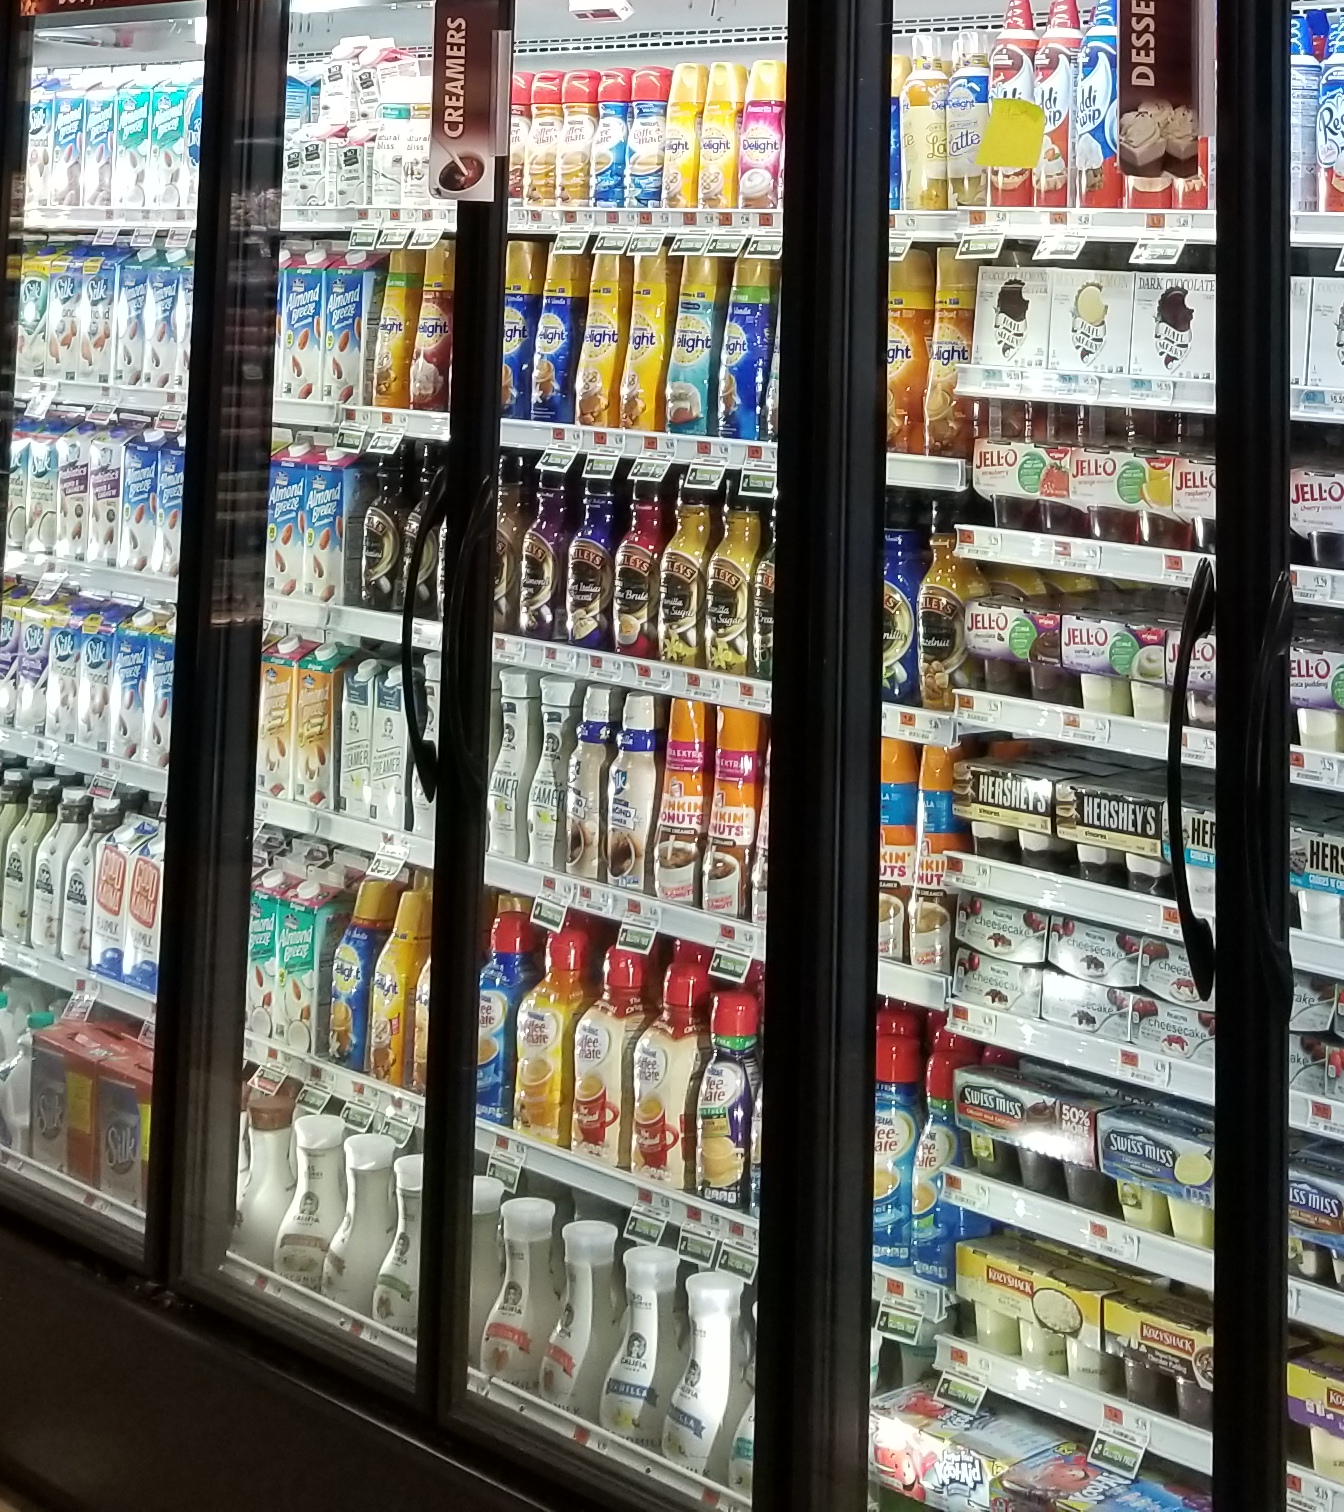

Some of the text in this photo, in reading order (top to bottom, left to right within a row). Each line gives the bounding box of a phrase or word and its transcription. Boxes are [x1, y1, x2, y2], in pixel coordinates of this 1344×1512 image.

[443, 16, 467, 138] CREAMERS
[742, 138, 779, 153] Delight
[1138, 277, 1163, 290] DARK
[287, 284, 320, 309] Almond
[327, 285, 360, 312] Almond
[269, 480, 304, 504] Almond
[307, 483, 341, 506] Almond
[1291, 481, 1344, 504] JELL-O
[313, 501, 337, 522] Breeze
[25, 627, 44, 651] Silk
[55, 634, 74, 657] Silk
[85, 640, 106, 664] Silk
[978, 774, 1046, 813] HERSHEY'S
[1083, 795, 1156, 835] HERSHEY'S
[280, 926, 313, 947] Almond
[964, 1088, 1022, 1119] SWISS MISS
[1061, 1104, 1091, 1127] 50%
[107, 1121, 136, 1164] Silk
[1110, 1134, 1175, 1168] SWISS MISS
[988, 1268, 1033, 1295] KOZYSHACK
[1142, 1324, 1194, 1352] KOZYSHACK
